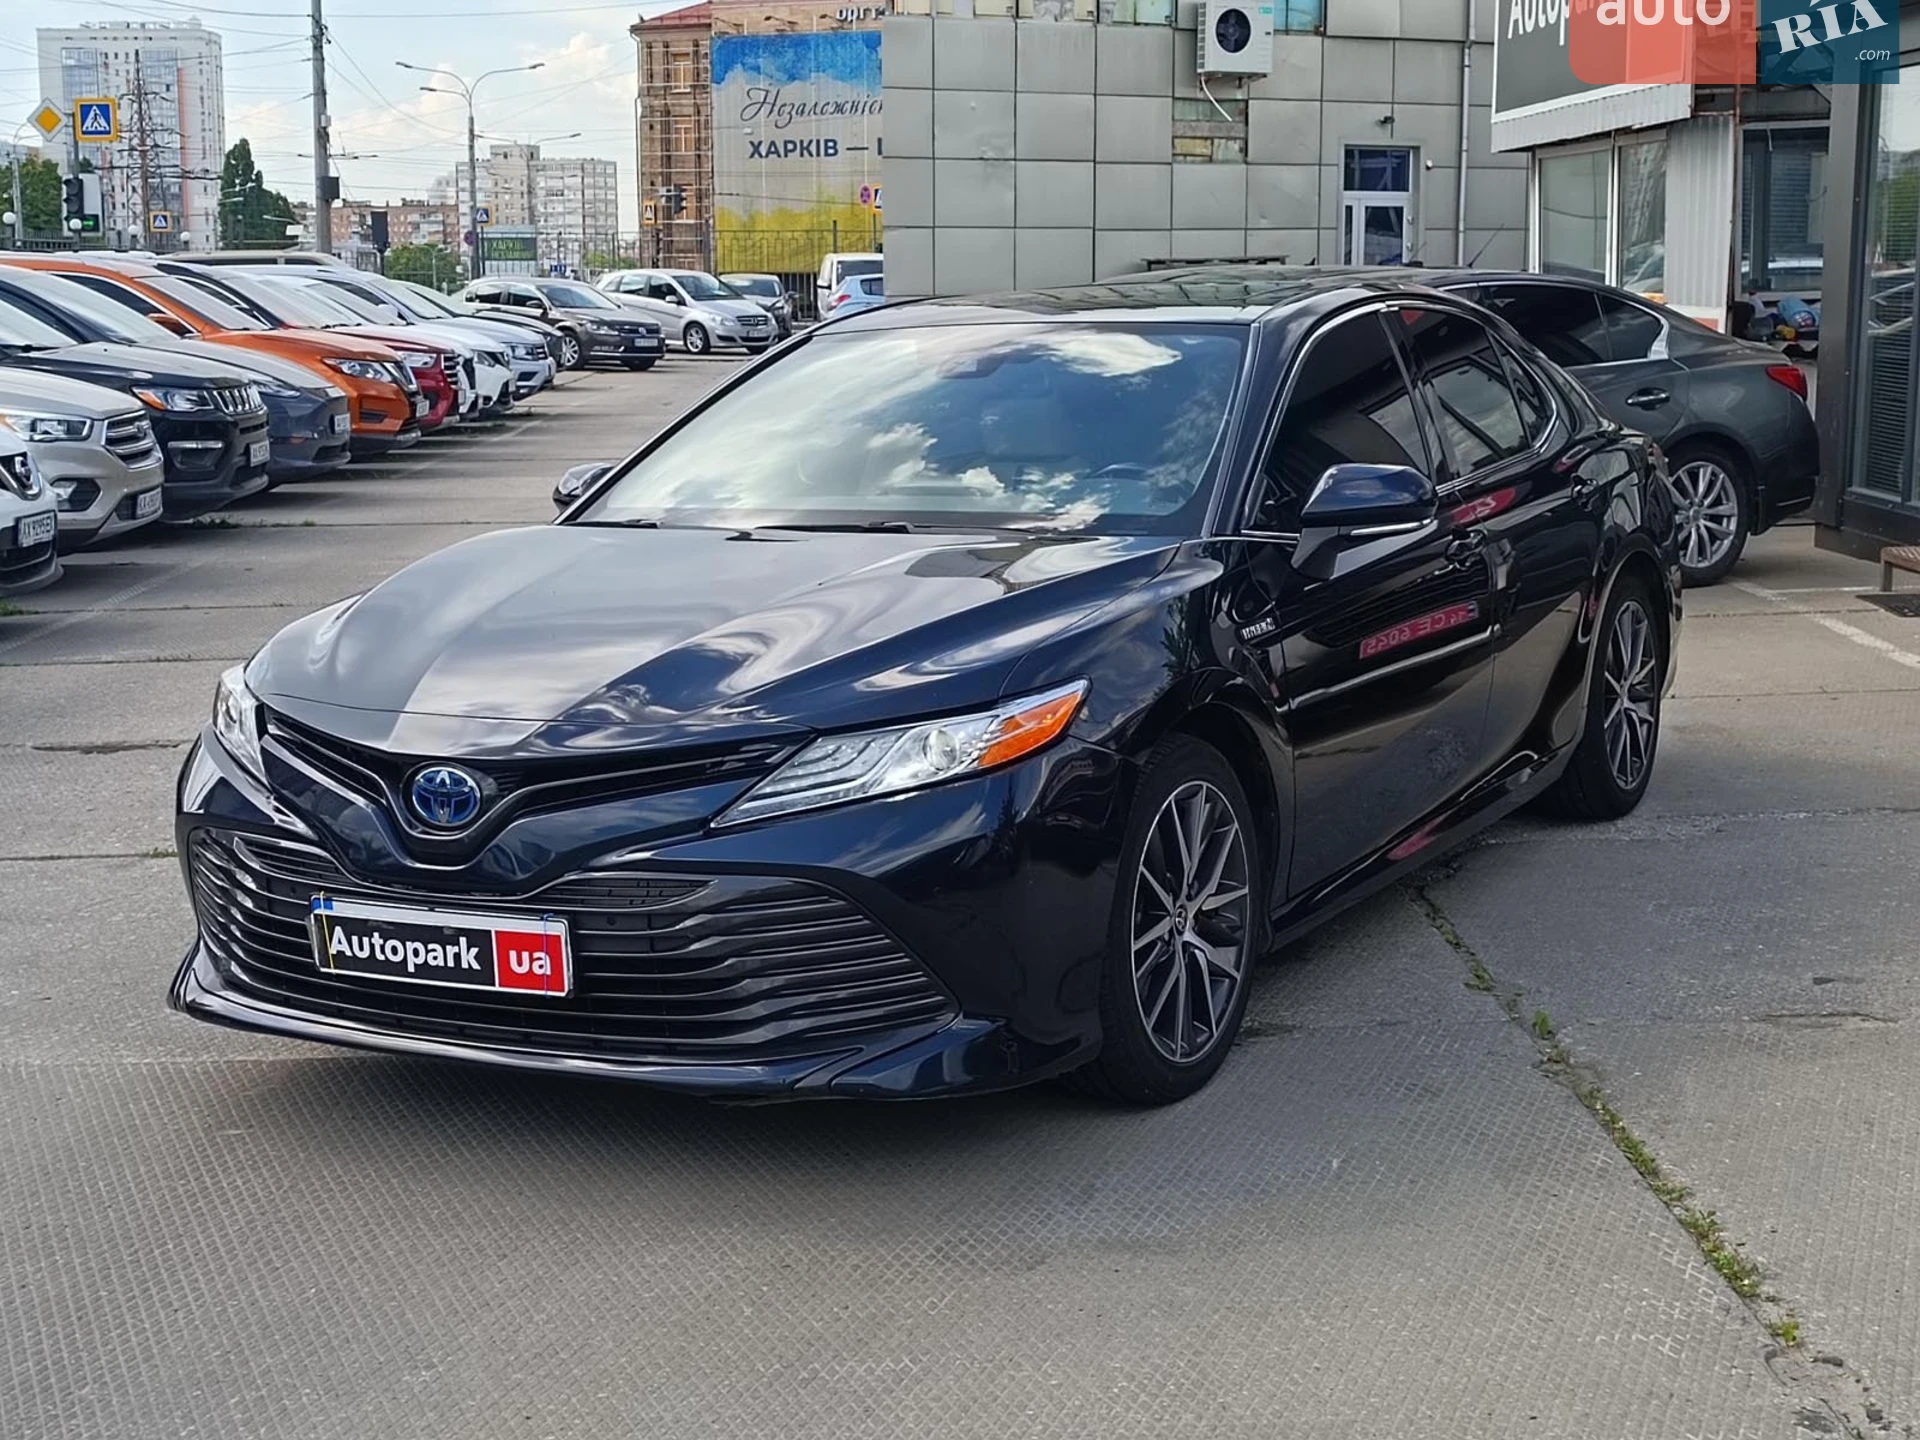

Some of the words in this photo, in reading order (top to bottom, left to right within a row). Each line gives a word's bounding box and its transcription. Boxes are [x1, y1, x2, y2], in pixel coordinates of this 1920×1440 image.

[748, 138, 839, 159] ХАРКІВ
[330, 926, 481, 972] Autopark
[508, 948, 552, 976] ua
